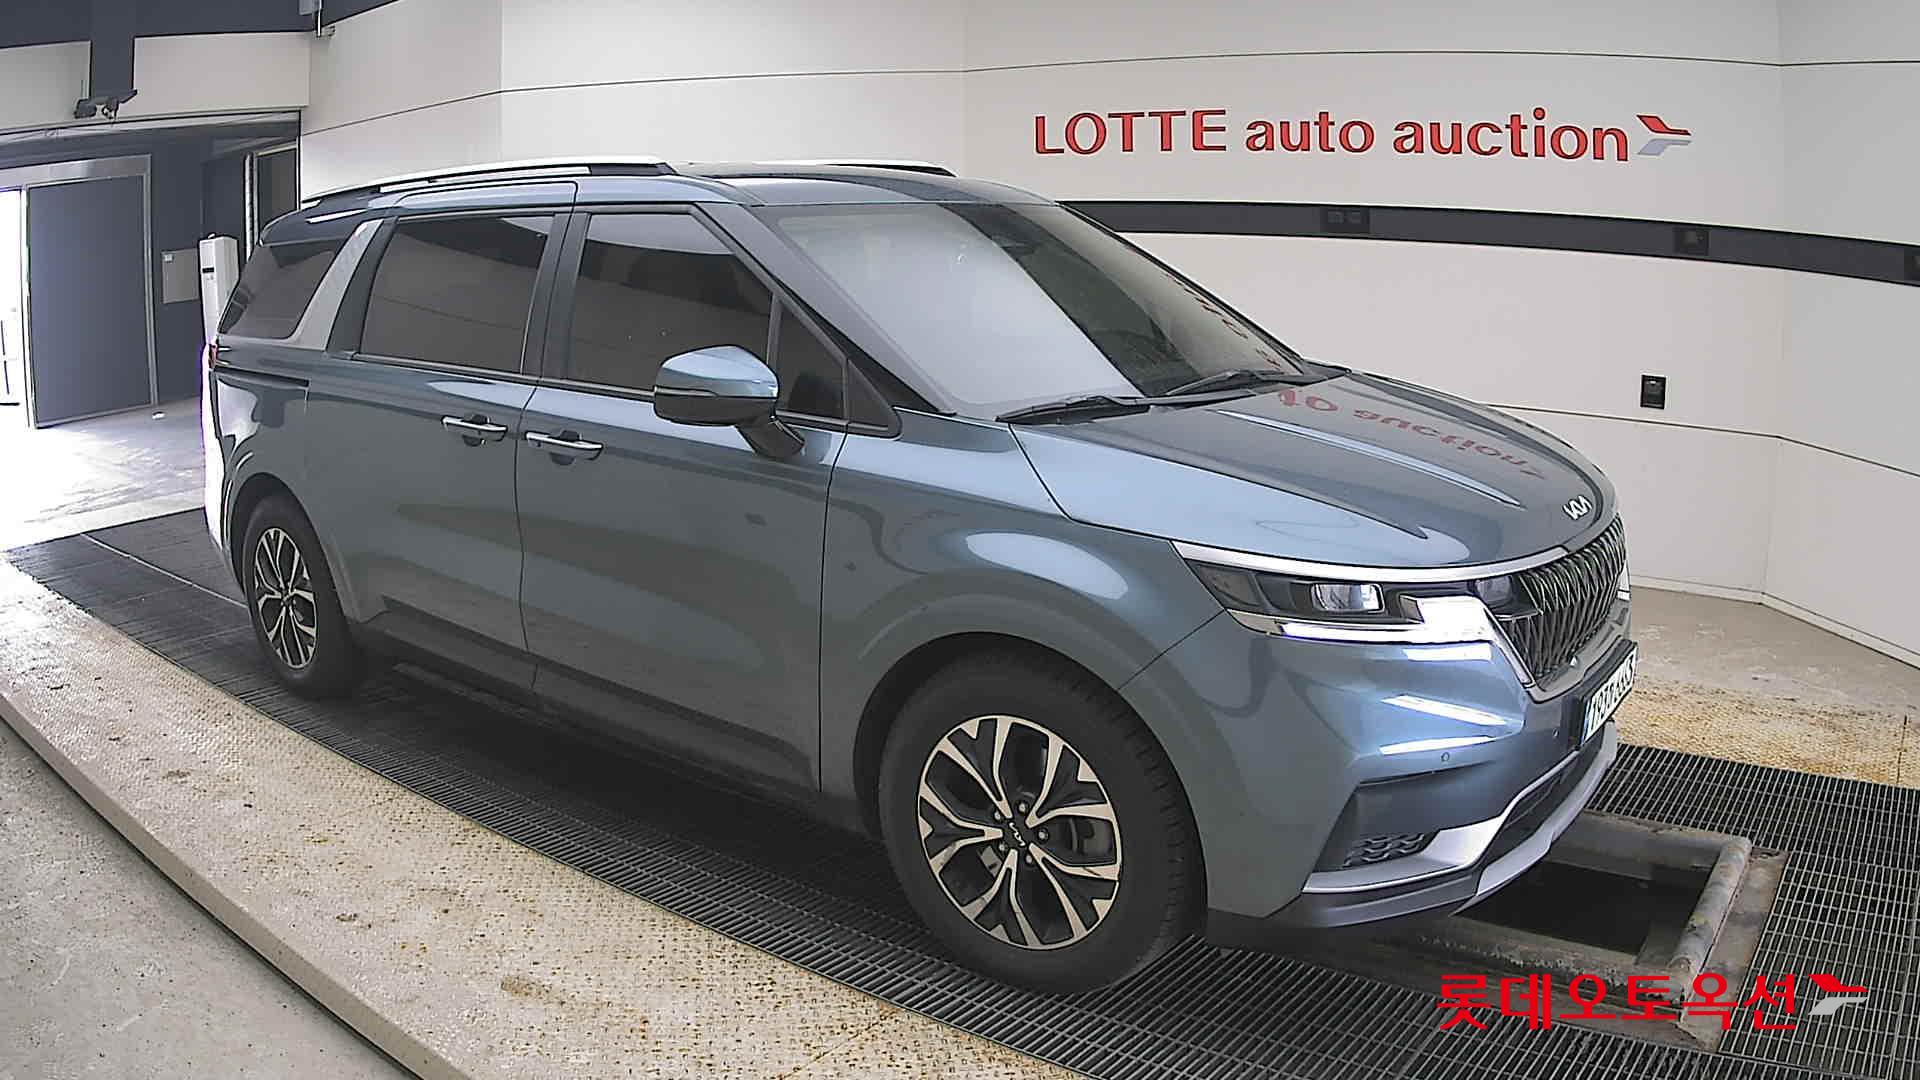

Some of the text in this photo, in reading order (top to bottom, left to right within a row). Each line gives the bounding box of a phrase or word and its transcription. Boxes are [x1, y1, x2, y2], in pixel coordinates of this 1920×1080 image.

[1034, 107, 1629, 162] LOTTE auto auction
